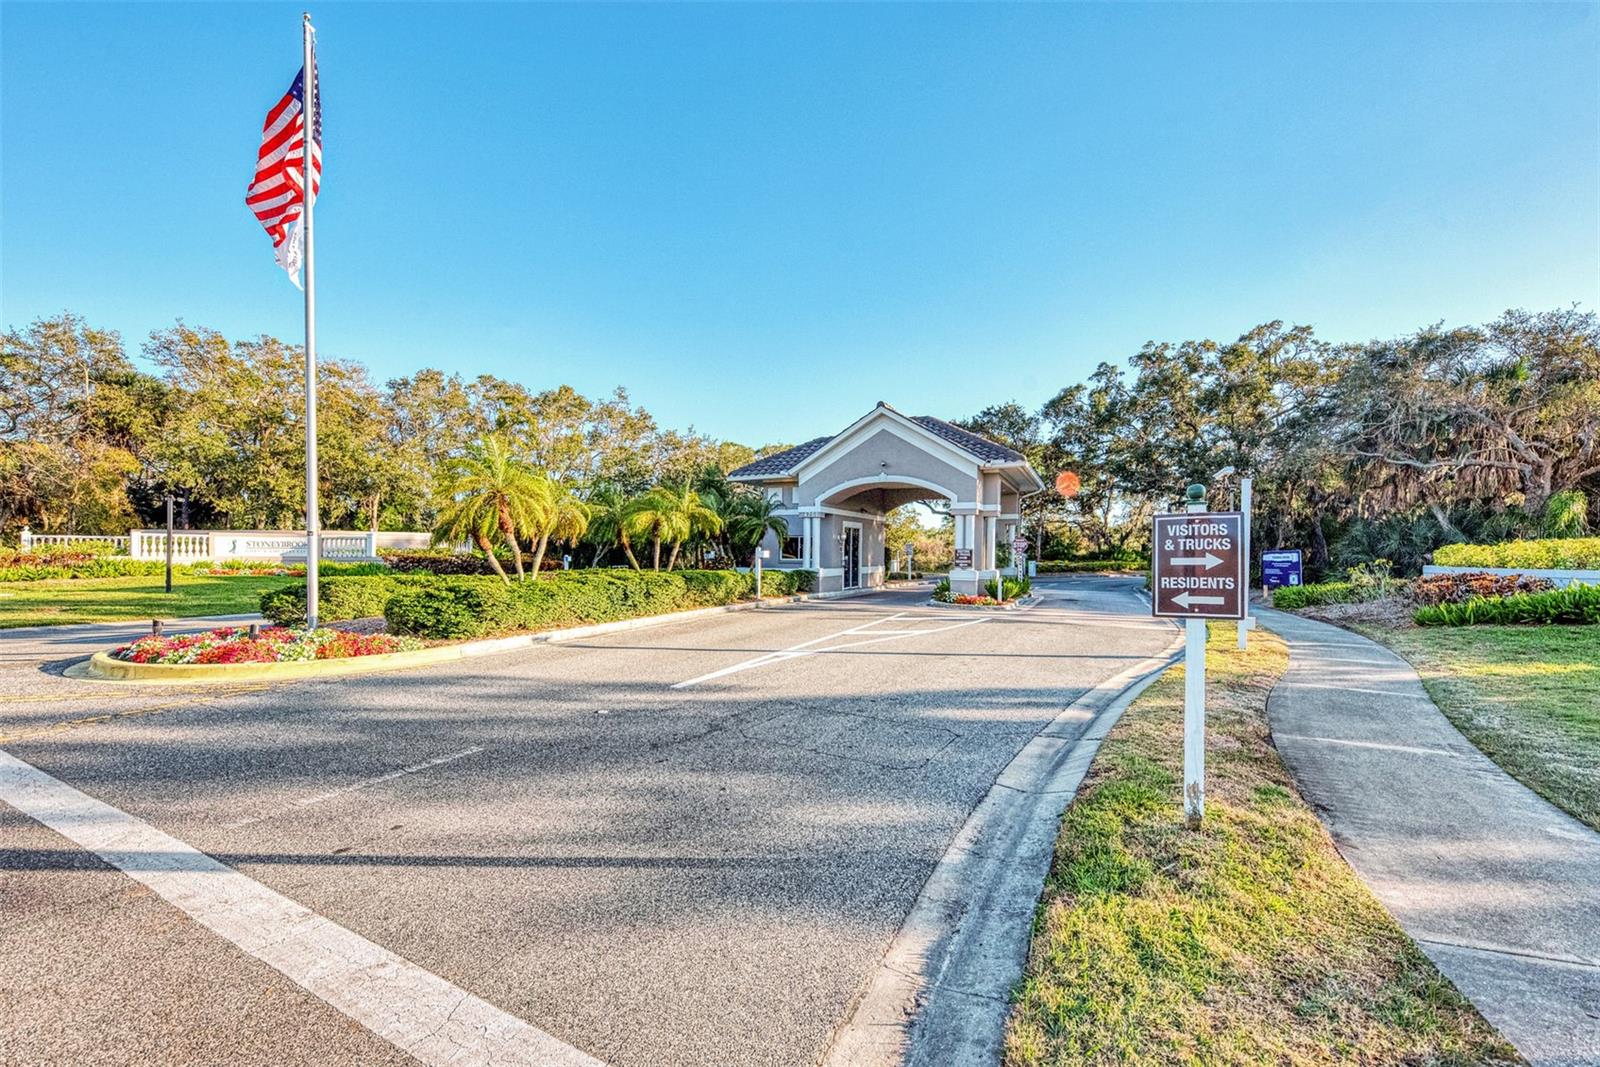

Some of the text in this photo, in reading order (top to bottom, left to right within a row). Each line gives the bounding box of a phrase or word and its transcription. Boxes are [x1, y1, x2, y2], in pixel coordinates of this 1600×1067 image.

[1167, 523, 1228, 537] VISITORS
[1164, 537, 1232, 551] & TRUCKS
[1161, 576, 1235, 590] RESIDENTS
